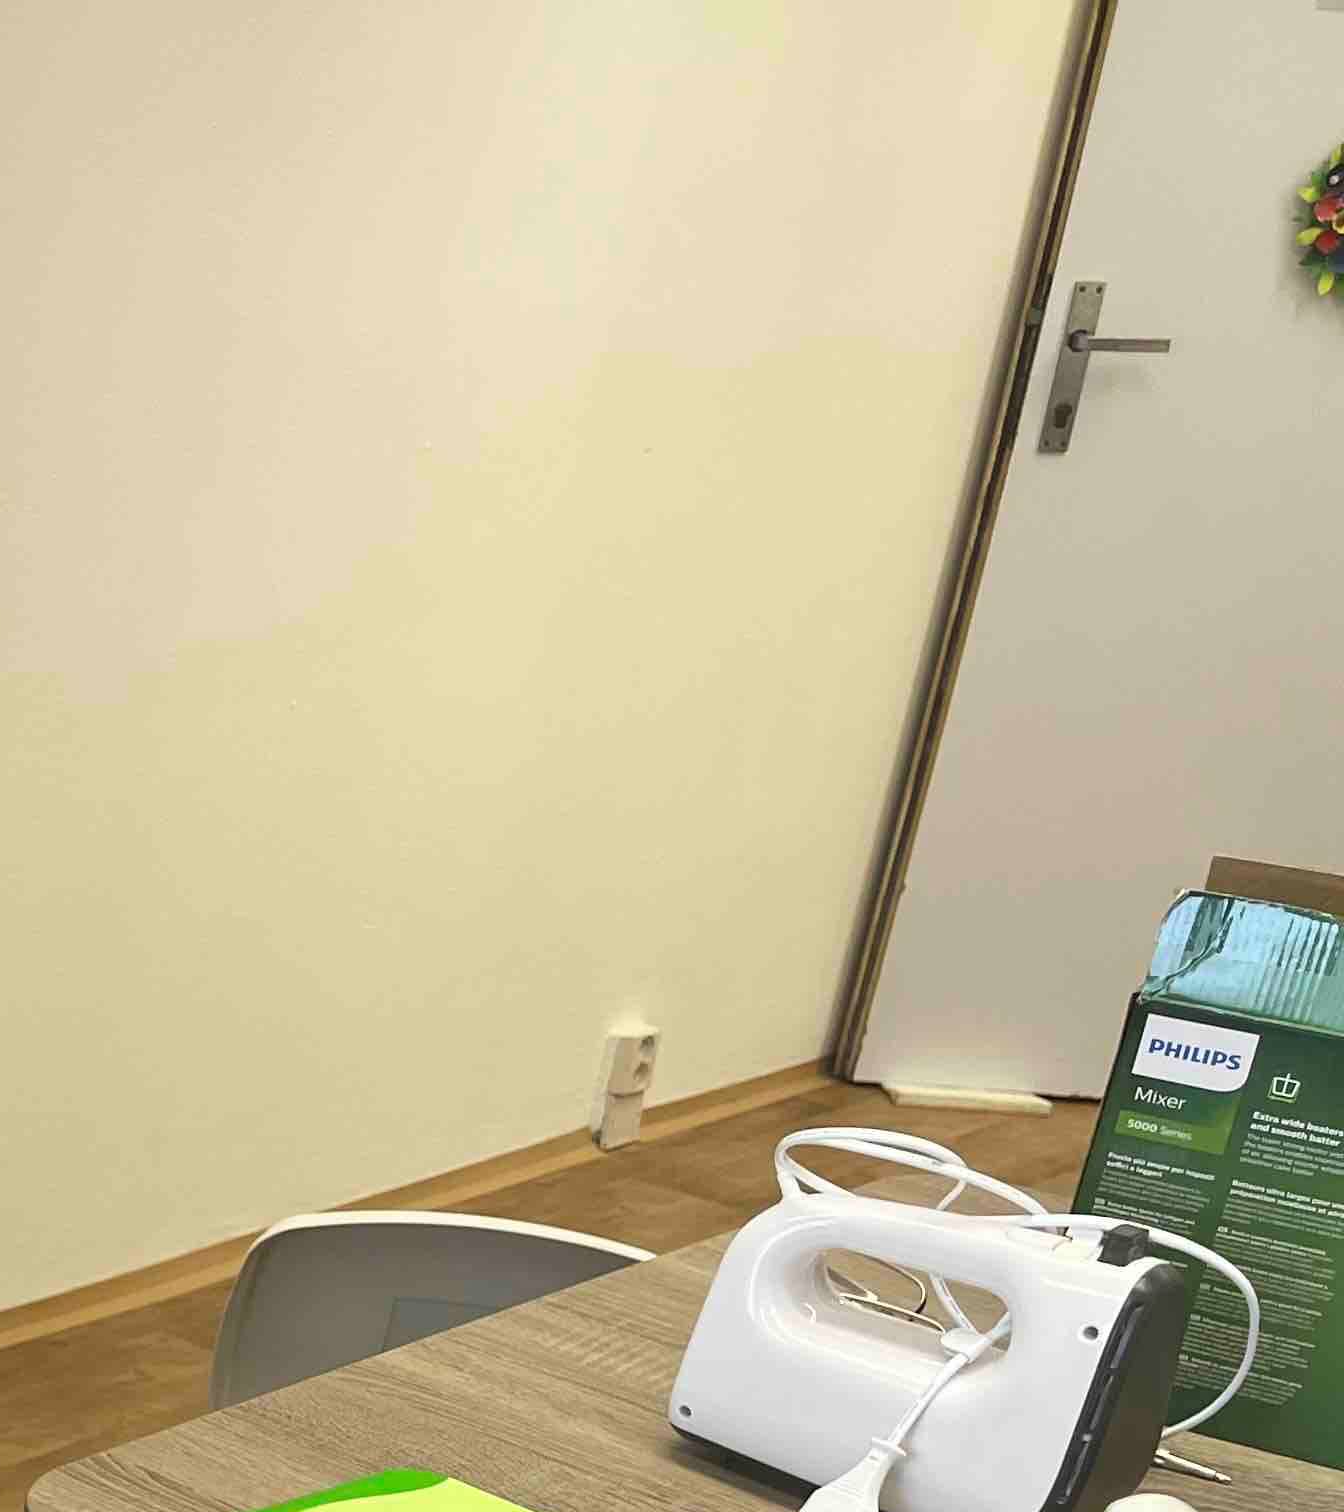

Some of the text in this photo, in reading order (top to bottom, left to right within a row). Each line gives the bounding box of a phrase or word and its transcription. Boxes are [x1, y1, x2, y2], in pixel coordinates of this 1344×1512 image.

[1149, 1038, 1242, 1071] PHILIPS
[1134, 1086, 1187, 1110] Mixer
[1127, 1118, 1158, 1133] 5000
